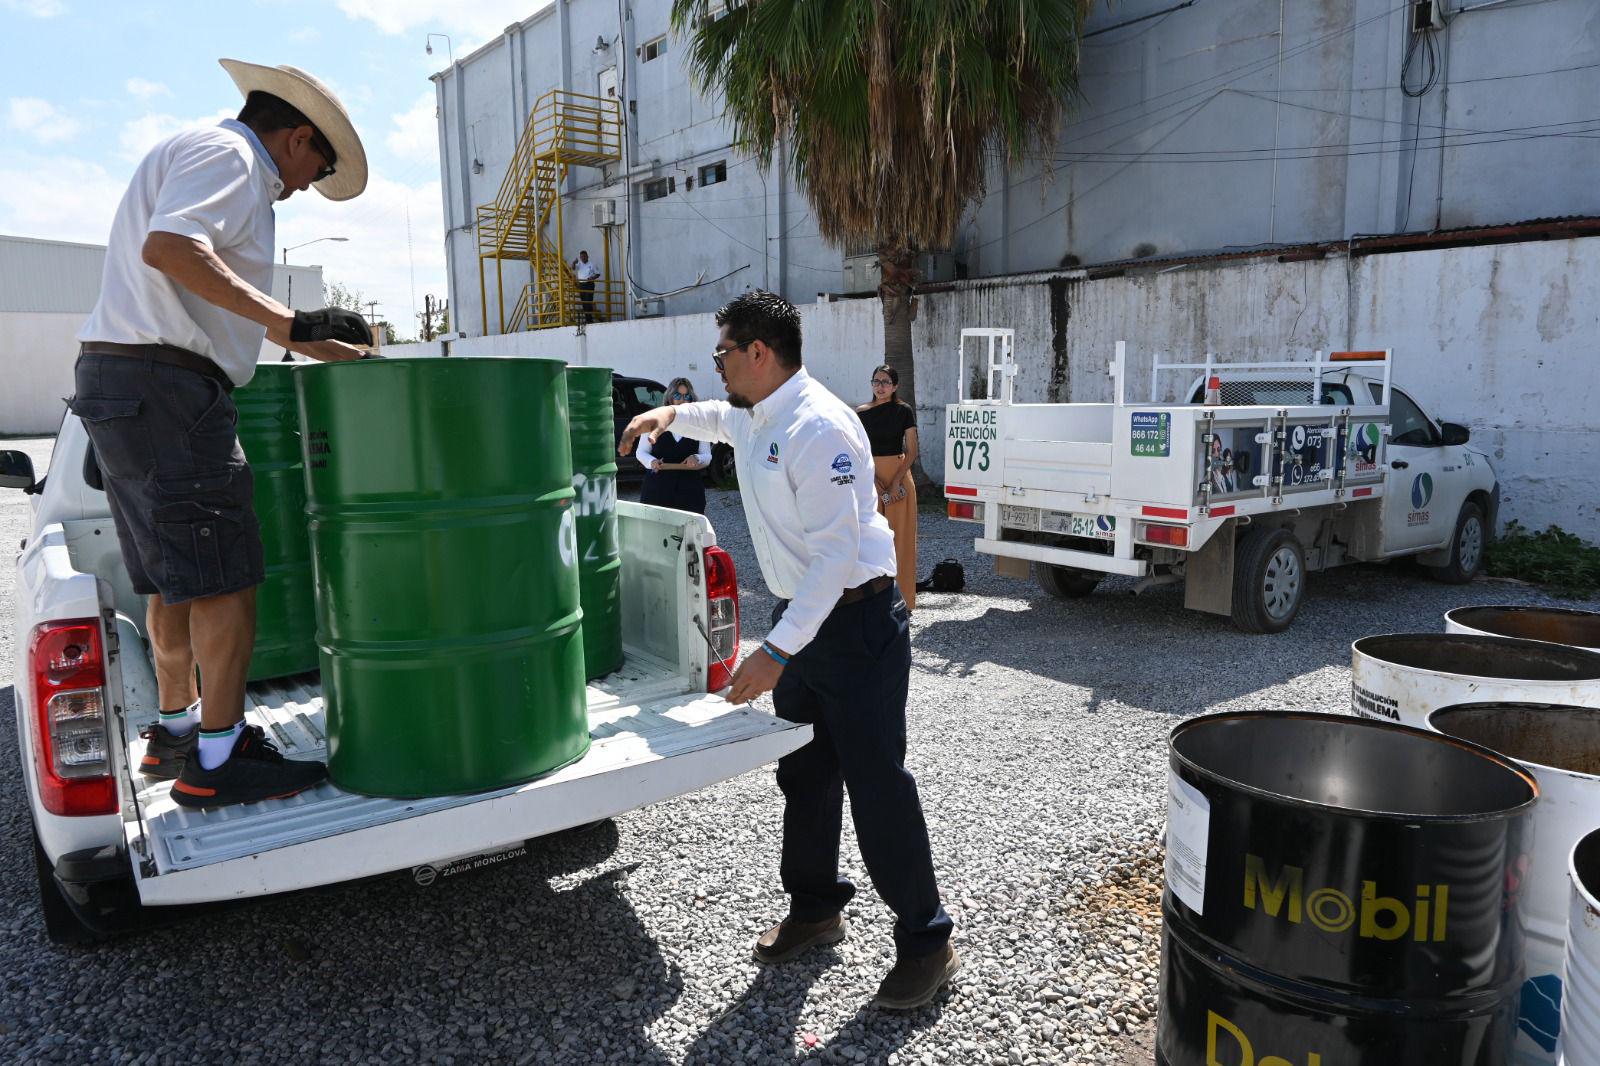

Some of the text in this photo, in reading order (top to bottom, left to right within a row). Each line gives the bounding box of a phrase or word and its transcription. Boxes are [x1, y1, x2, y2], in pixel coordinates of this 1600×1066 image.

[950, 407, 997, 425] LÍNEA DE
[1132, 415, 1158, 424] WhatsApp
[948, 425, 997, 440] ATENCIÓN
[1131, 430, 1159, 440] 866 172
[1135, 443, 1155, 453] 46 44
[1307, 435, 1322, 449] 073
[953, 440, 990, 472] 073
[1407, 510, 1430, 523] simas
[1072, 517, 1095, 537] 25-12
[442, 863, 472, 877] ZAMA
[474, 848, 528, 869] MONCLOVA
[1242, 853, 1450, 943] Mobil
